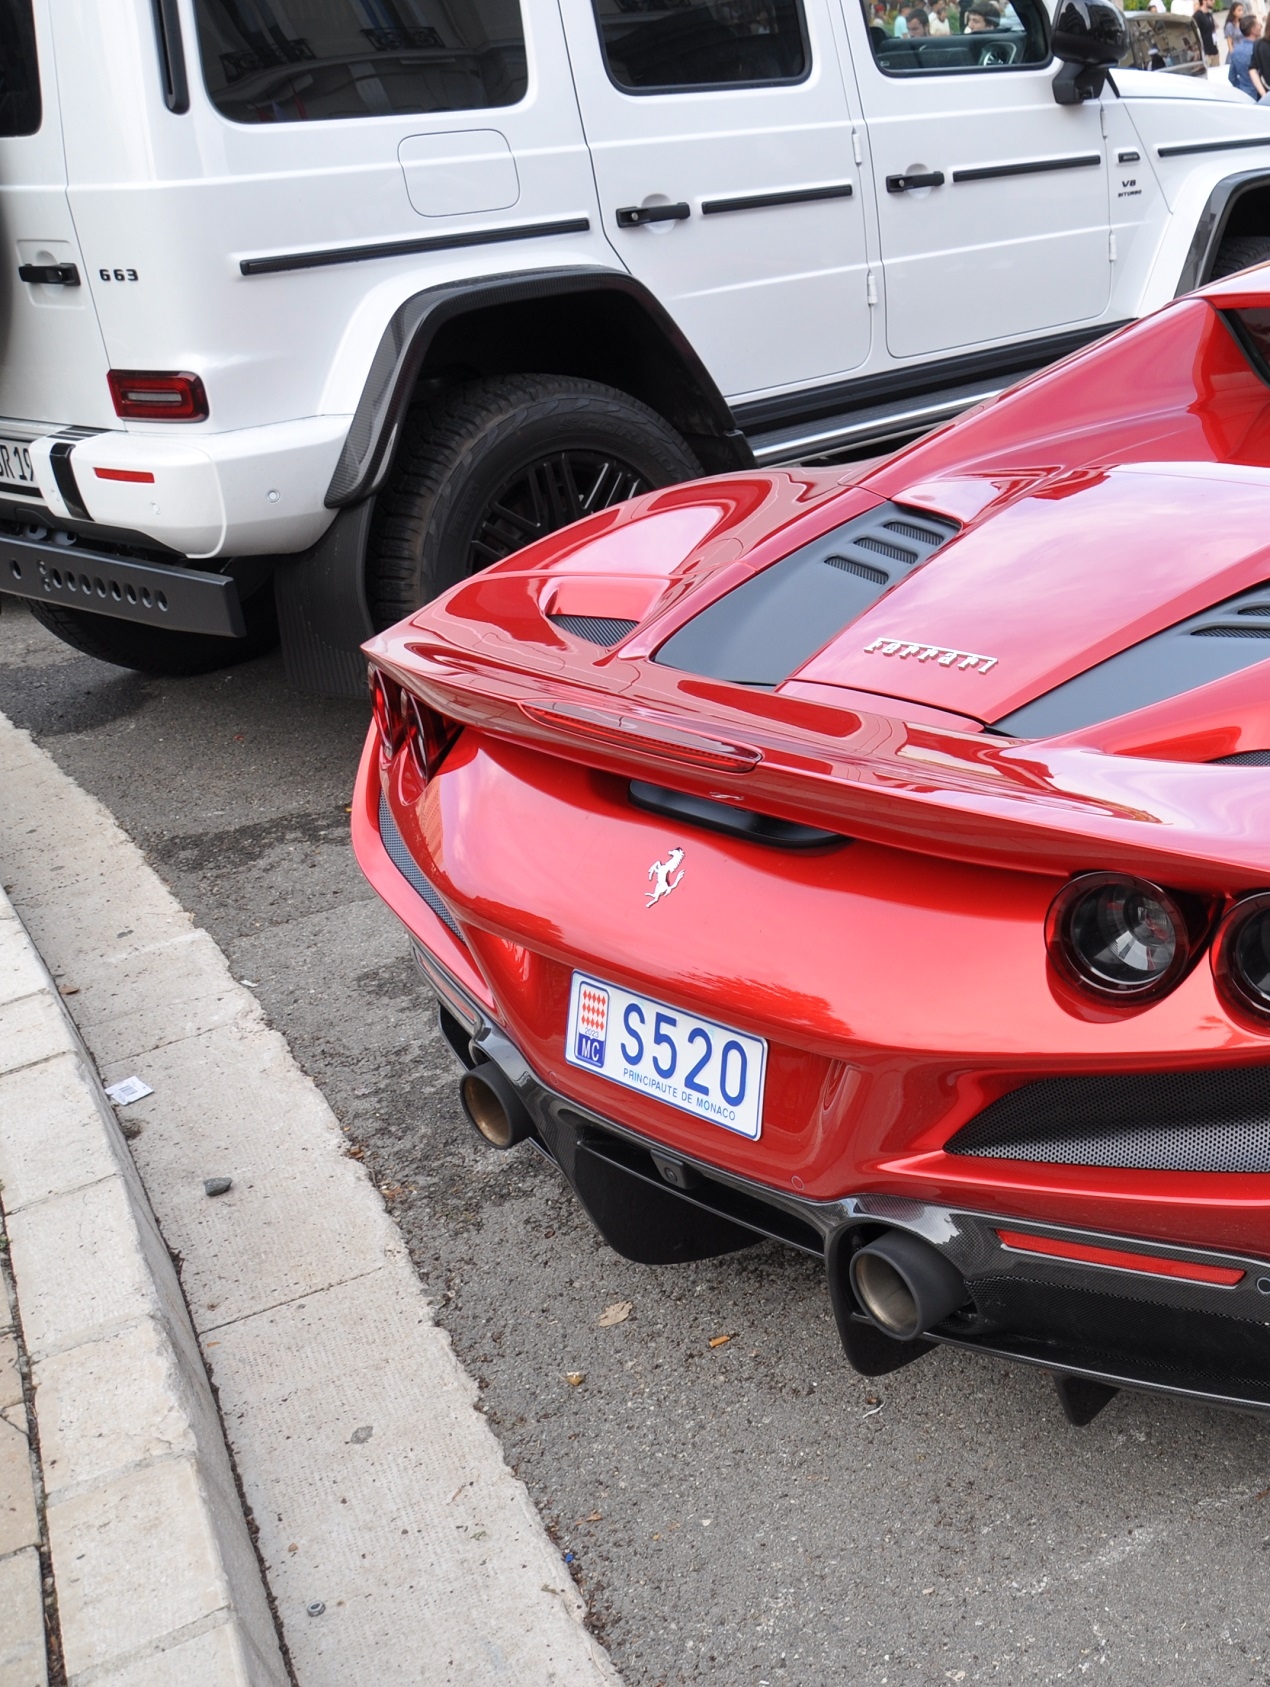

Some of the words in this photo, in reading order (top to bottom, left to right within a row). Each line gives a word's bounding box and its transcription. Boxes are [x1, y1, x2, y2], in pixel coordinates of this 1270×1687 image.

[1122, 179, 1136, 188] V8
[0, 444, 15, 479] R
[863, 637, 999, 675] Ferrari
[581, 1037, 600, 1062] MC
[585, 1027, 600, 1039] 2023
[620, 1002, 748, 1107] S520
[623, 1067, 678, 1098] PRINCIPAUTE
[681, 1090, 693, 1104] DE
[696, 1097, 736, 1121] MONACO
